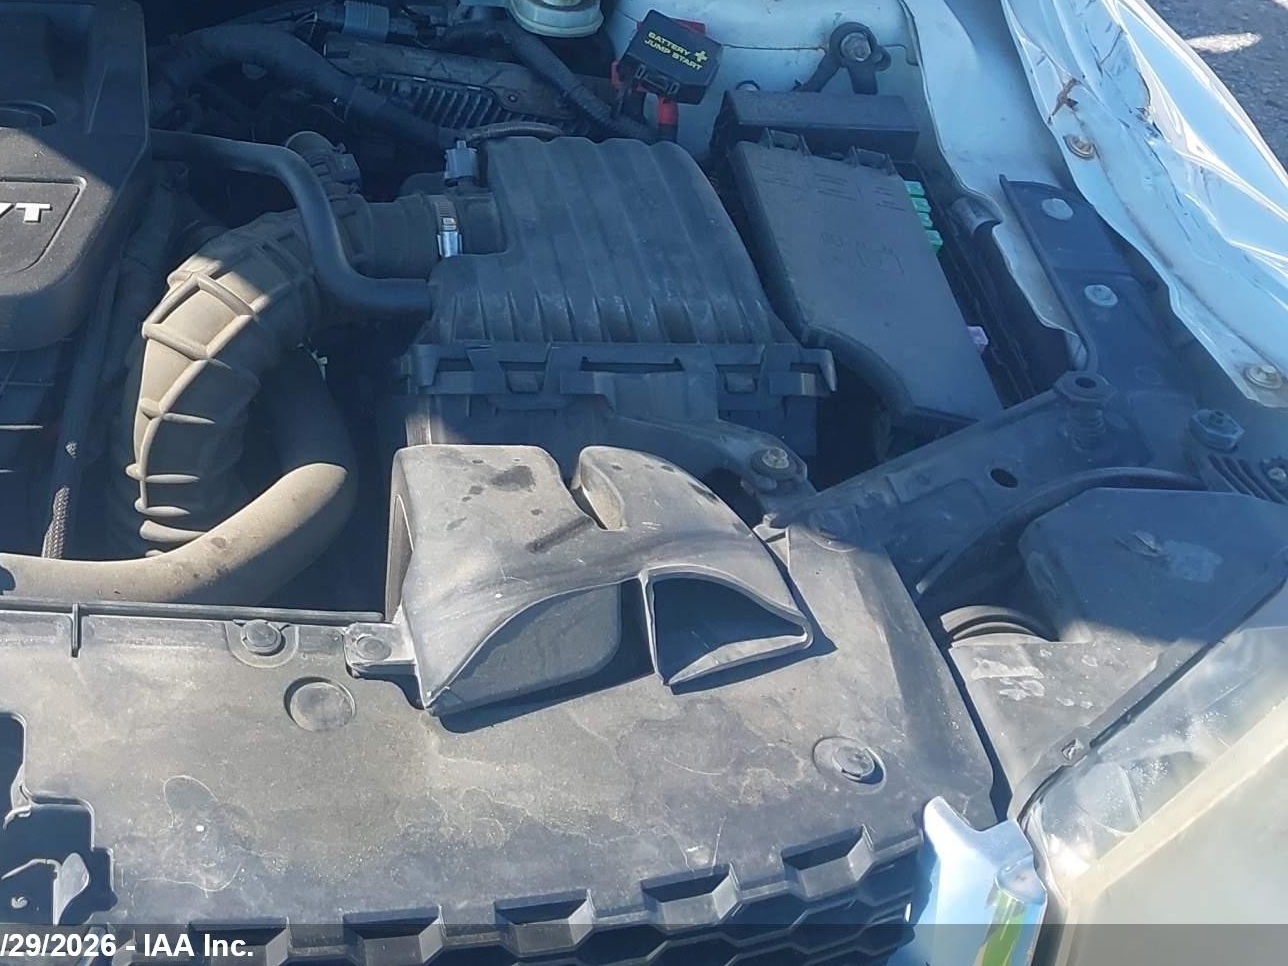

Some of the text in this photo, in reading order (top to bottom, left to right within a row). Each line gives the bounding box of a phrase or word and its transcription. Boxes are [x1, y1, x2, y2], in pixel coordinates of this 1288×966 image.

[644, 38, 703, 71] JUMP START
[647, 31, 691, 56] BATTERY
